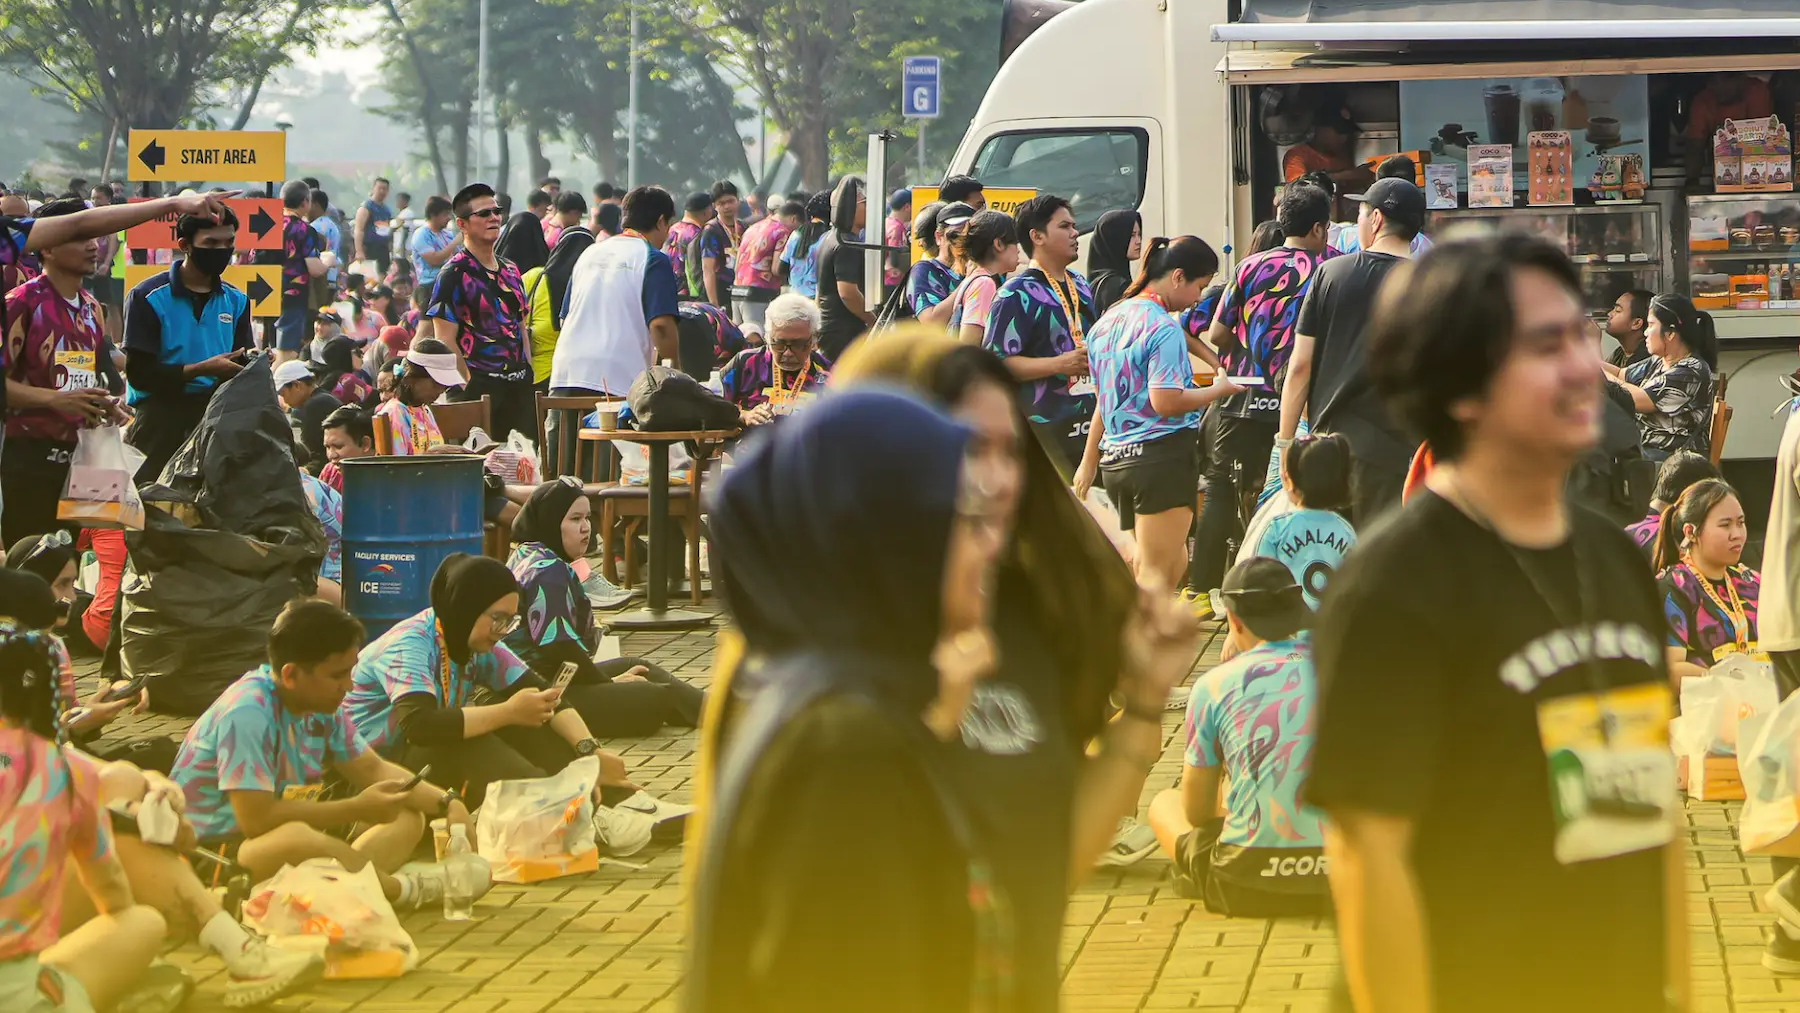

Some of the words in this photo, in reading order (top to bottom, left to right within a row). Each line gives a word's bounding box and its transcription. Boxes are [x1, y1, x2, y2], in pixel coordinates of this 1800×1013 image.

[913, 86, 929, 112] G
[181, 149, 220, 165] START
[223, 149, 257, 165] AREA
[1248, 397, 1280, 411] JCO
[1281, 528, 1348, 559] HAALAN
[380, 553, 416, 562] SERVICES
[360, 581, 379, 594] ICE
